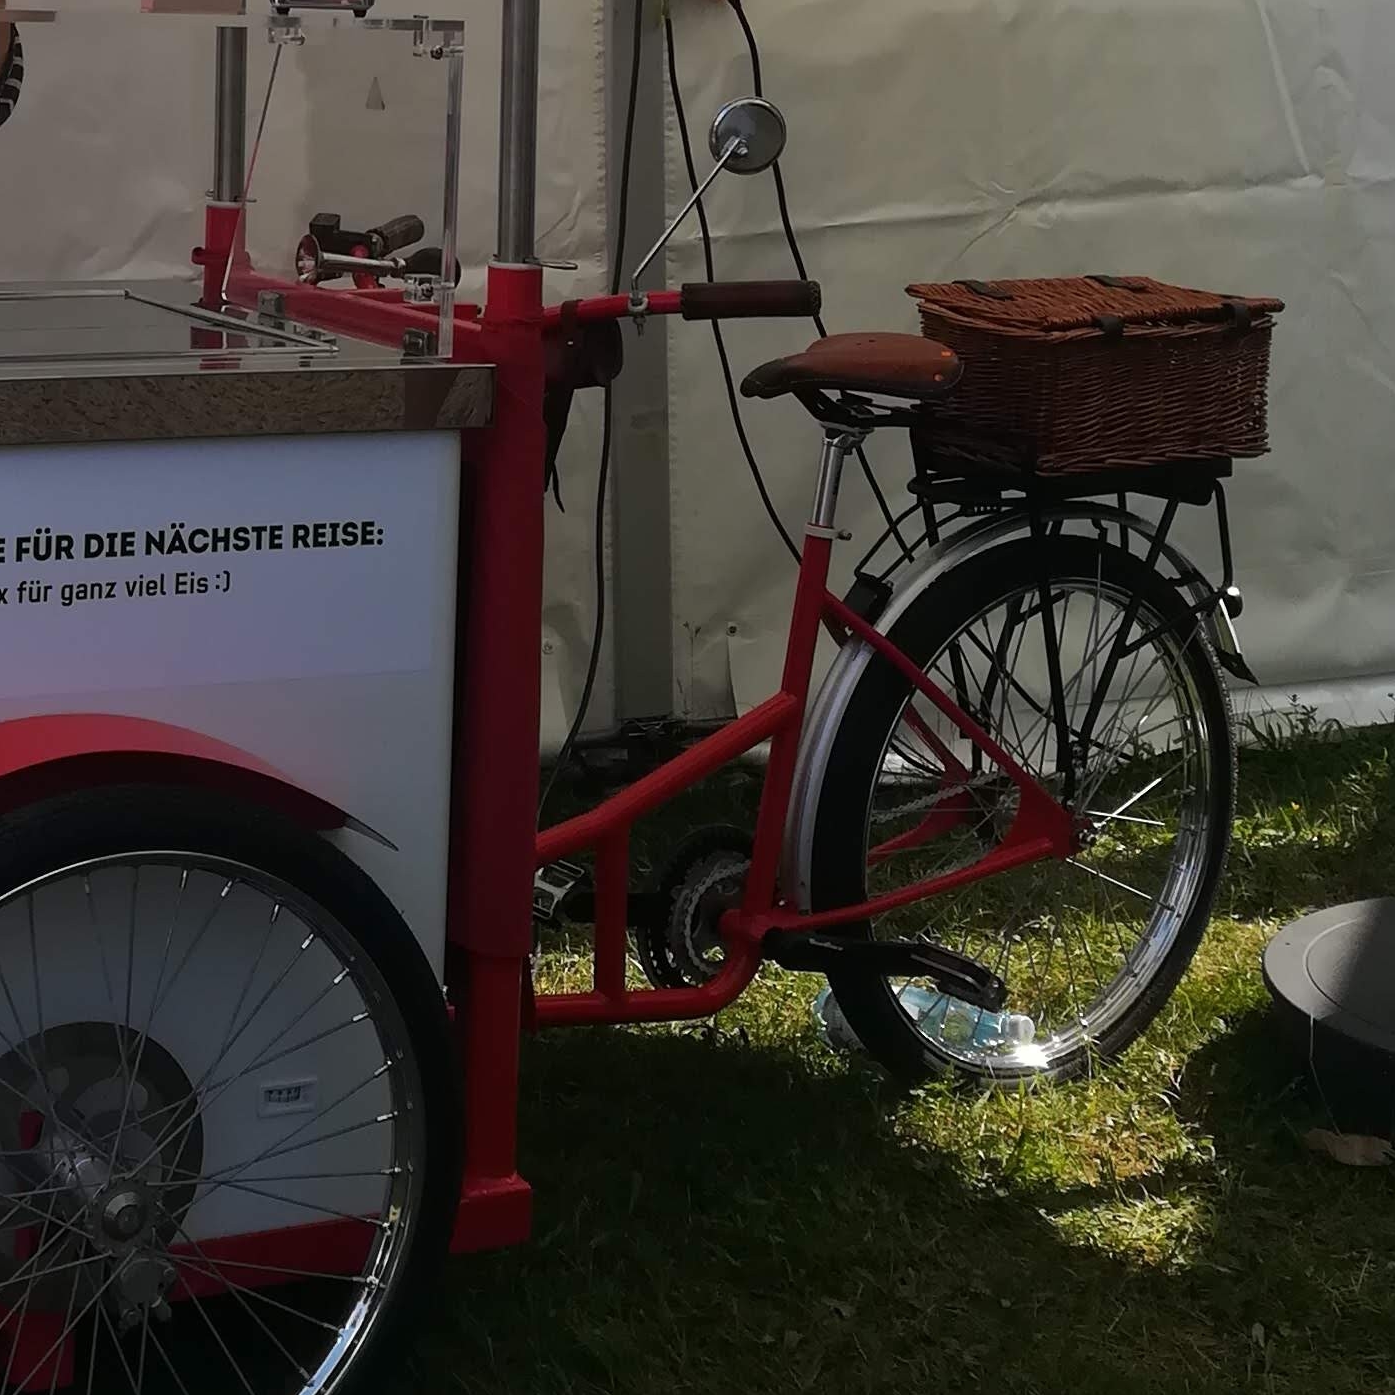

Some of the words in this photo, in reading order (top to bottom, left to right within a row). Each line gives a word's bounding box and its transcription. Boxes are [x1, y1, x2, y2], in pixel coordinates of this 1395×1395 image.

[15, 527, 75, 563] FÜR
[83, 531, 136, 559] DIE
[144, 522, 284, 556] NÄCHSTE
[292, 520, 384, 549] REISE:
[16, 580, 53, 604] für
[60, 581, 118, 608] ganz
[124, 572, 167, 598] viel
